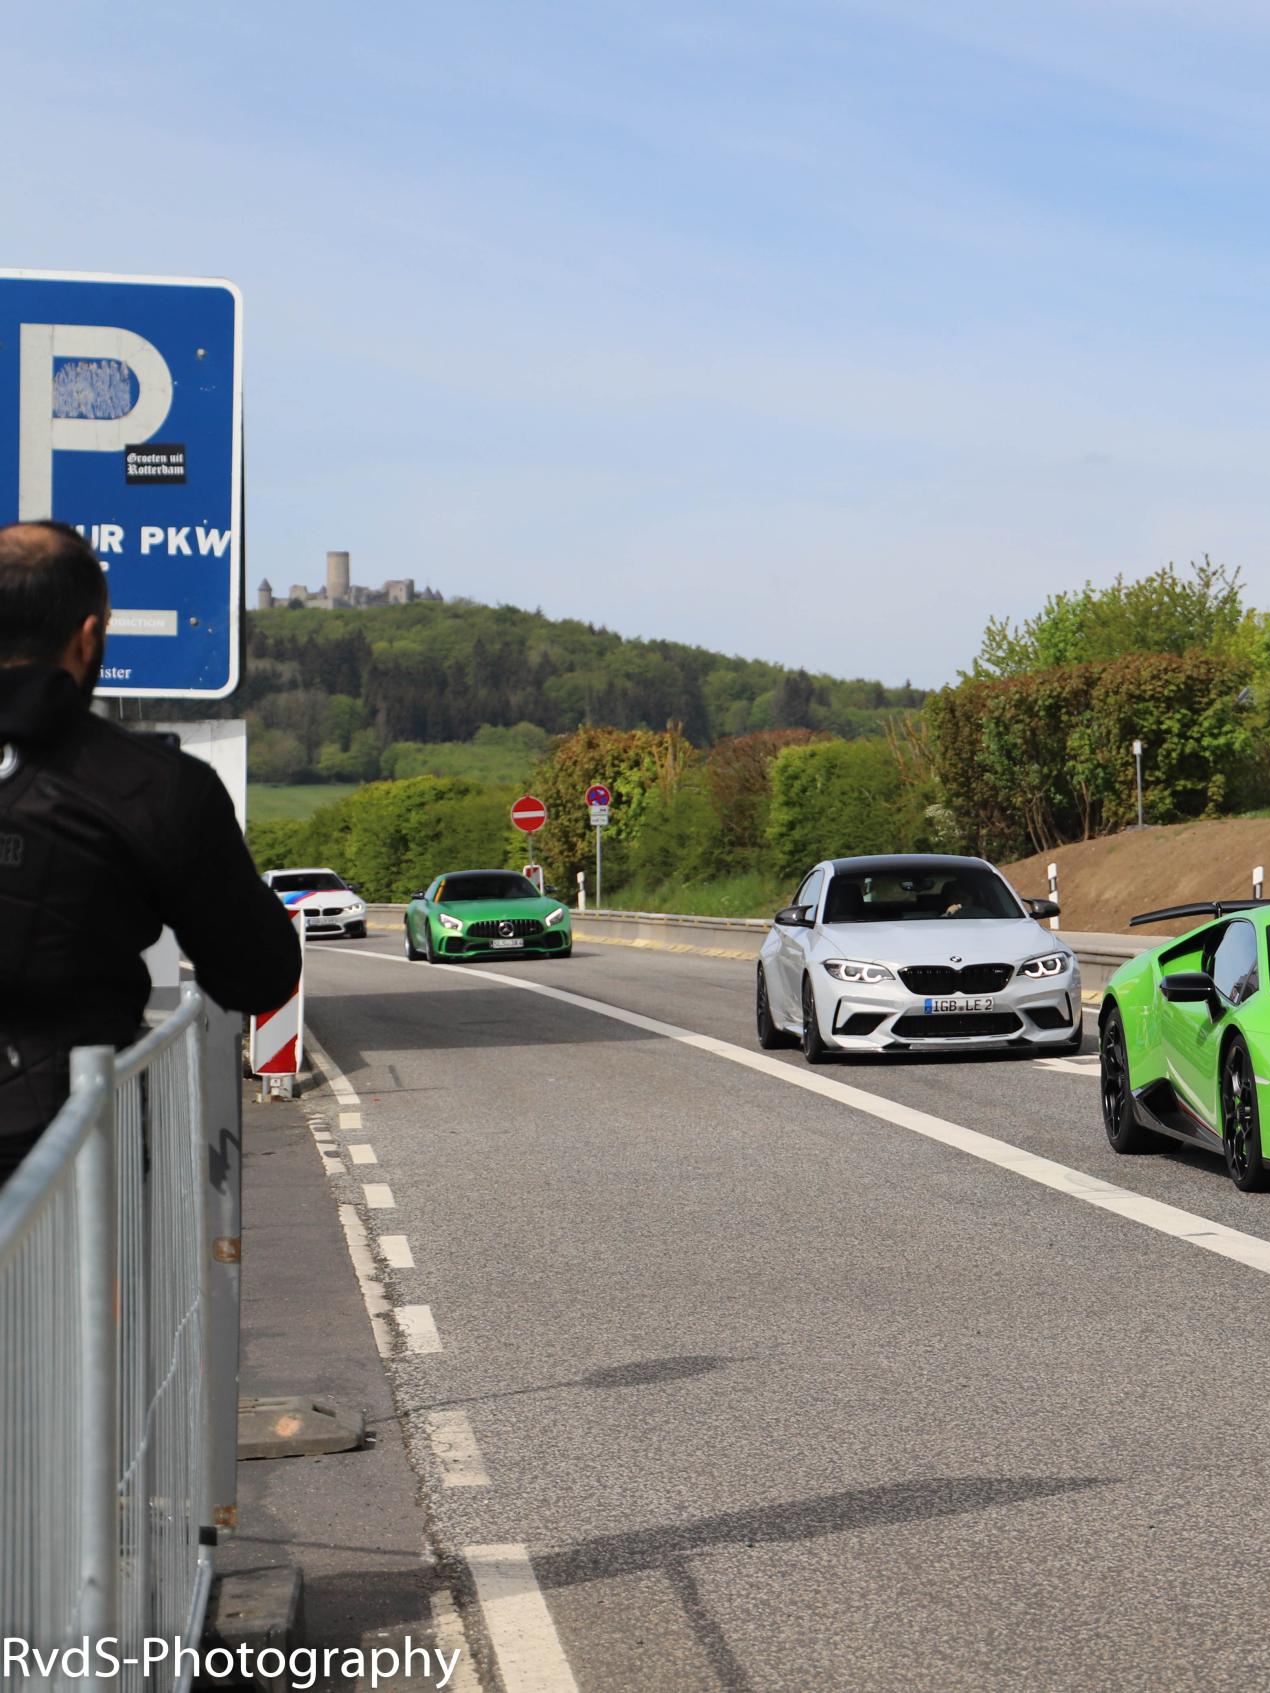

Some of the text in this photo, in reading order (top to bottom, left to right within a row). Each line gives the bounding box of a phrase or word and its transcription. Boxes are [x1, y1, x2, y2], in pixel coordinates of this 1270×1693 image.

[19, 323, 173, 522] P
[127, 453, 184, 463] Groeten uit
[127, 464, 185, 475] Rotterdam
[75, 524, 232, 557] UR PKW
[105, 618, 166, 628] DDICTION
[933, 999, 993, 1012] IGB LE 2
